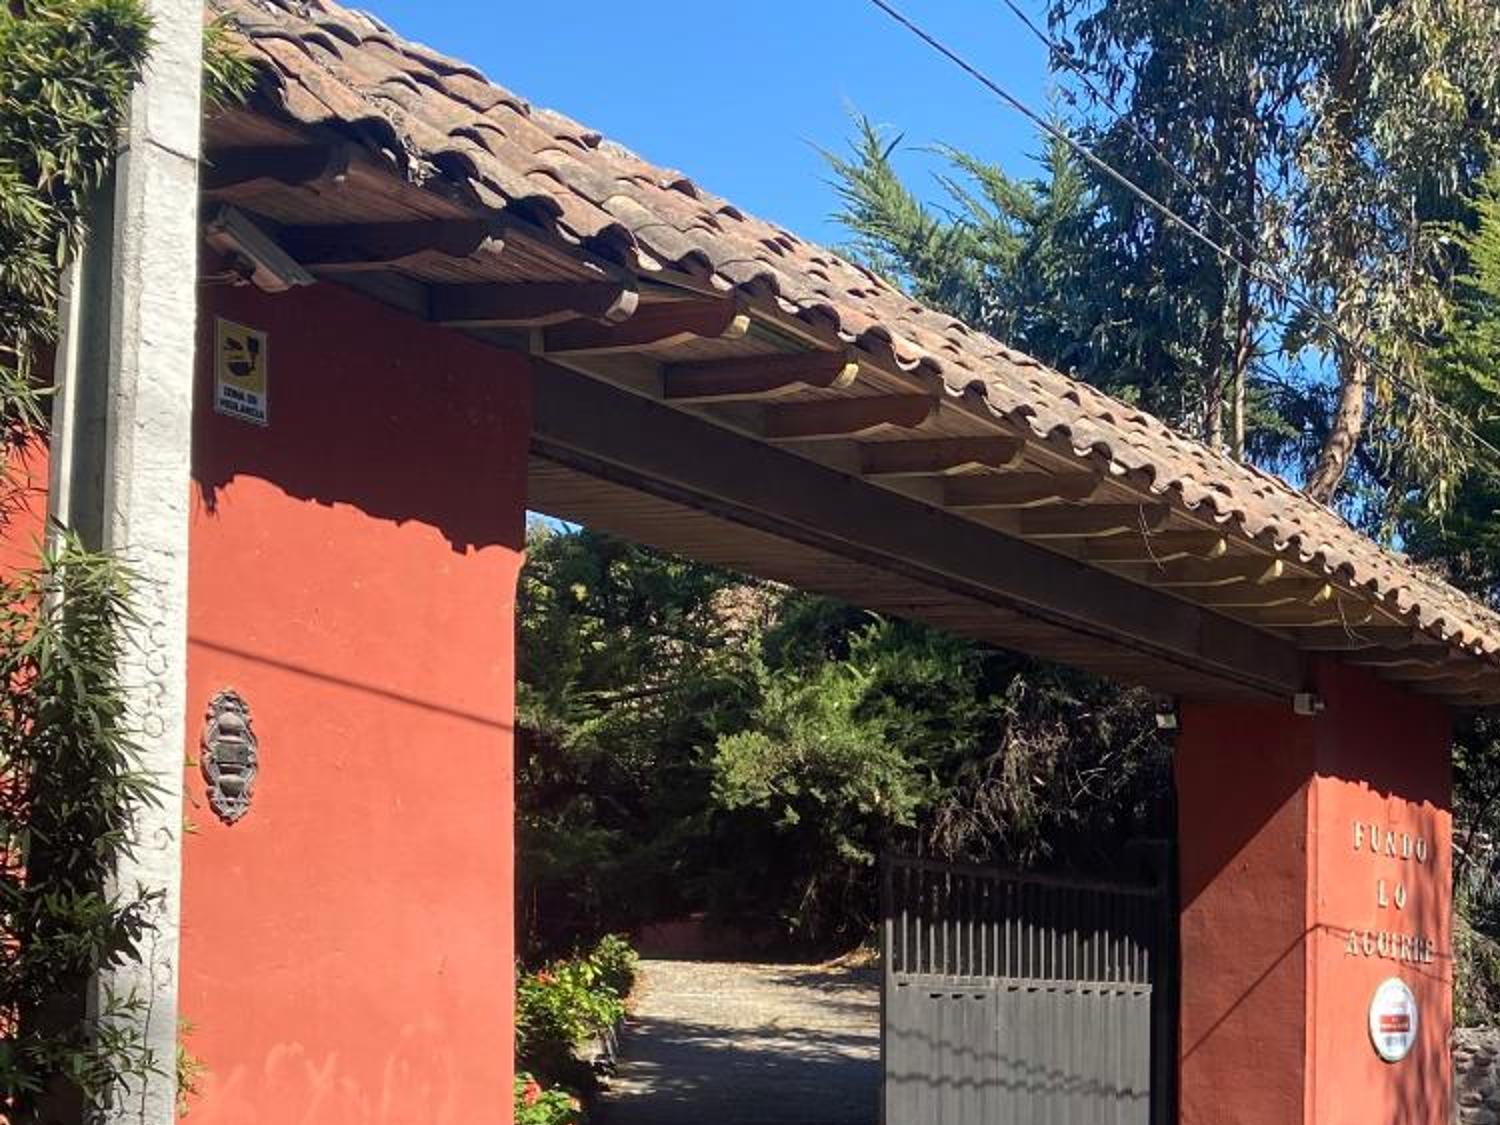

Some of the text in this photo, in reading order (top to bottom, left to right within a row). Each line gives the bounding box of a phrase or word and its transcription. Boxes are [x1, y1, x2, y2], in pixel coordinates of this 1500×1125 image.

[1353, 821, 1427, 863] FUNDO
[1377, 879, 1407, 910] LO
[1345, 930, 1433, 964] AGUIRRE
